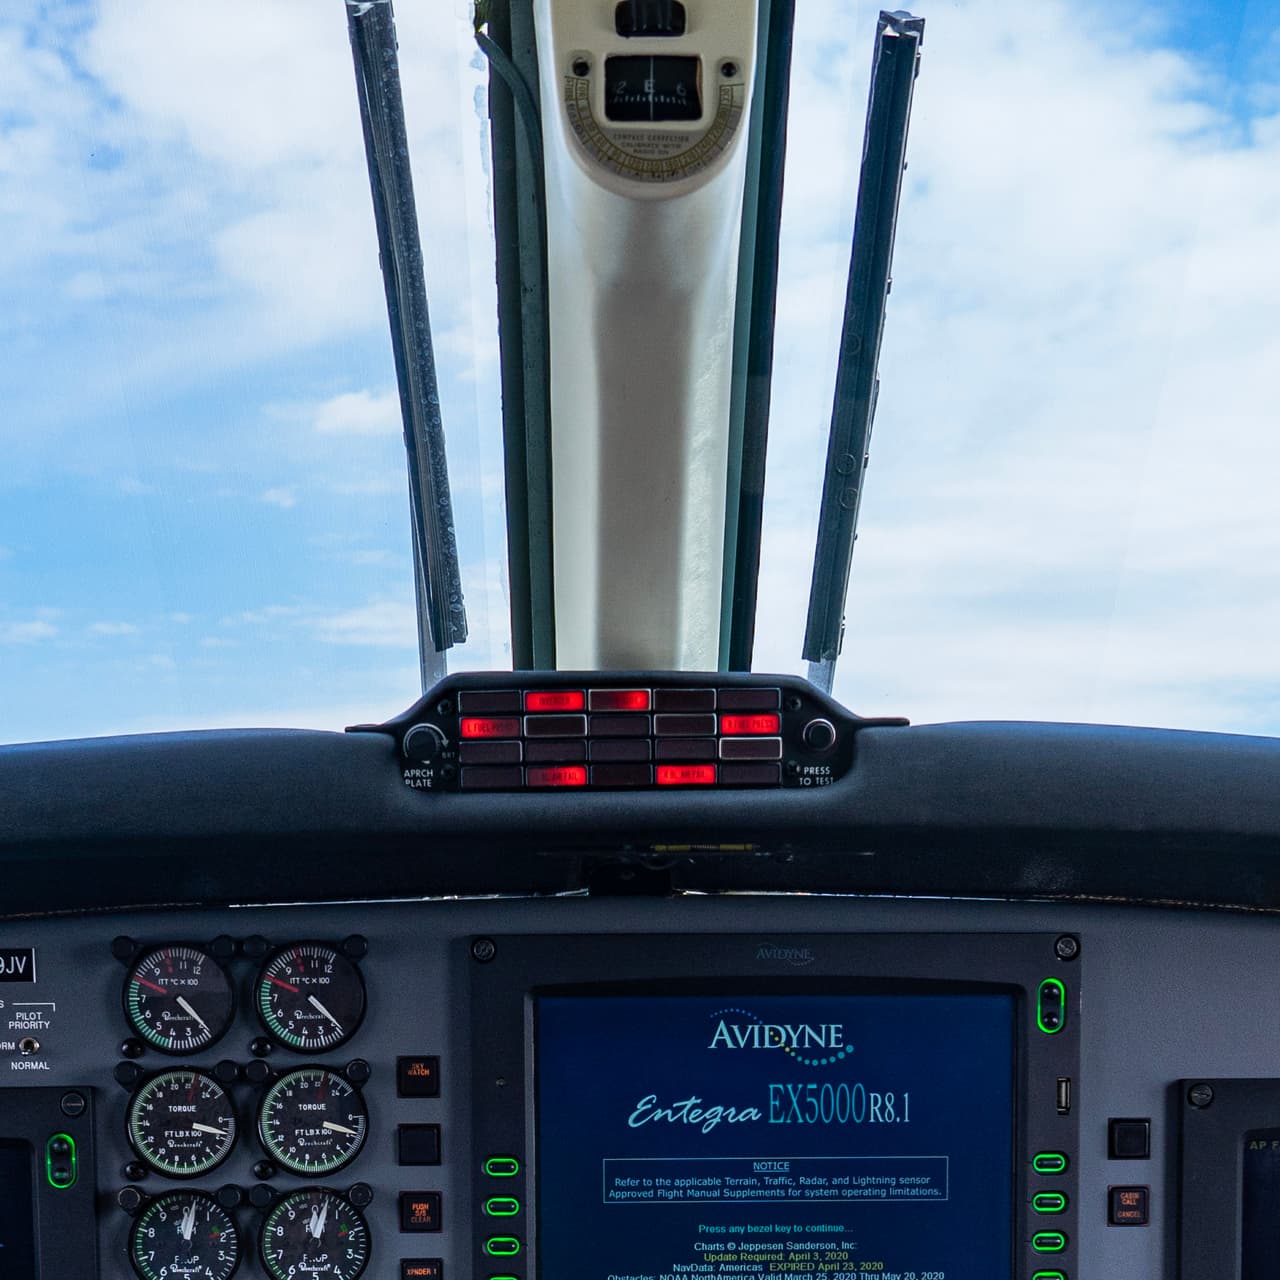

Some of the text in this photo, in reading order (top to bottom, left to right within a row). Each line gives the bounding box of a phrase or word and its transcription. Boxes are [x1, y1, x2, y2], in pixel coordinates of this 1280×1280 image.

[404, 769, 433, 778] APRCH
[804, 766, 830, 775] PRESS
[15, 1012, 42, 1020] PILOT
[9, 1021, 50, 1029] PRIORITY
[708, 1020, 844, 1049] AVIDYNE
[11, 1061, 50, 1070] NORMAL
[298, 1103, 326, 1111] TORQUE
[628, 1083, 910, 1133] Entegra EX5000 R8.1
[753, 1161, 790, 1170] NOTICE
[615, 1176, 931, 1187] Refer to the applicable Terrain, Traffic, Radar, and Lightning sensor
[609, 1187, 942, 1200] Approved Flight Manual Supplements for system operating limitations.
[699, 1225, 725, 1233] Press
[728, 1226, 745, 1234] any
[747, 1224, 773, 1233] bezel
[775, 1224, 792, 1234] key
[805, 1224, 854, 1232] continue...
